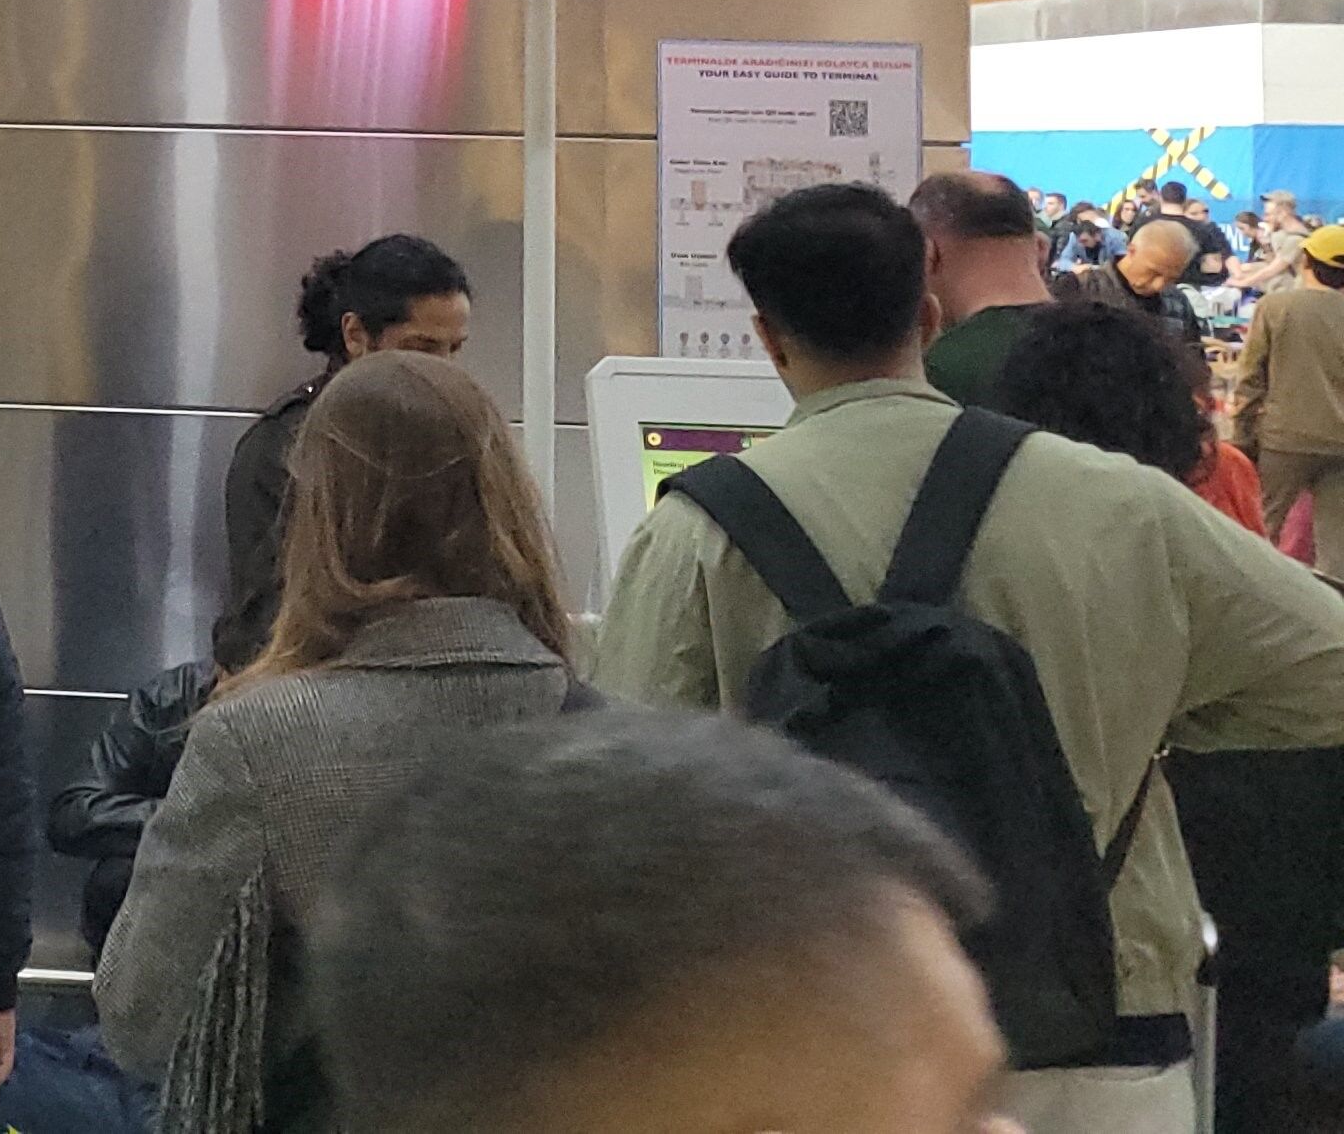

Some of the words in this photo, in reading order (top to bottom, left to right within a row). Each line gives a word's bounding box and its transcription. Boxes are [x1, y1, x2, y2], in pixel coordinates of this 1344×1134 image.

[699, 70, 729, 78] YOUR
[733, 70, 760, 79] EASY
[764, 71, 798, 79] GUIDE
[803, 71, 818, 79] TO
[822, 72, 879, 81] TERMINAL
